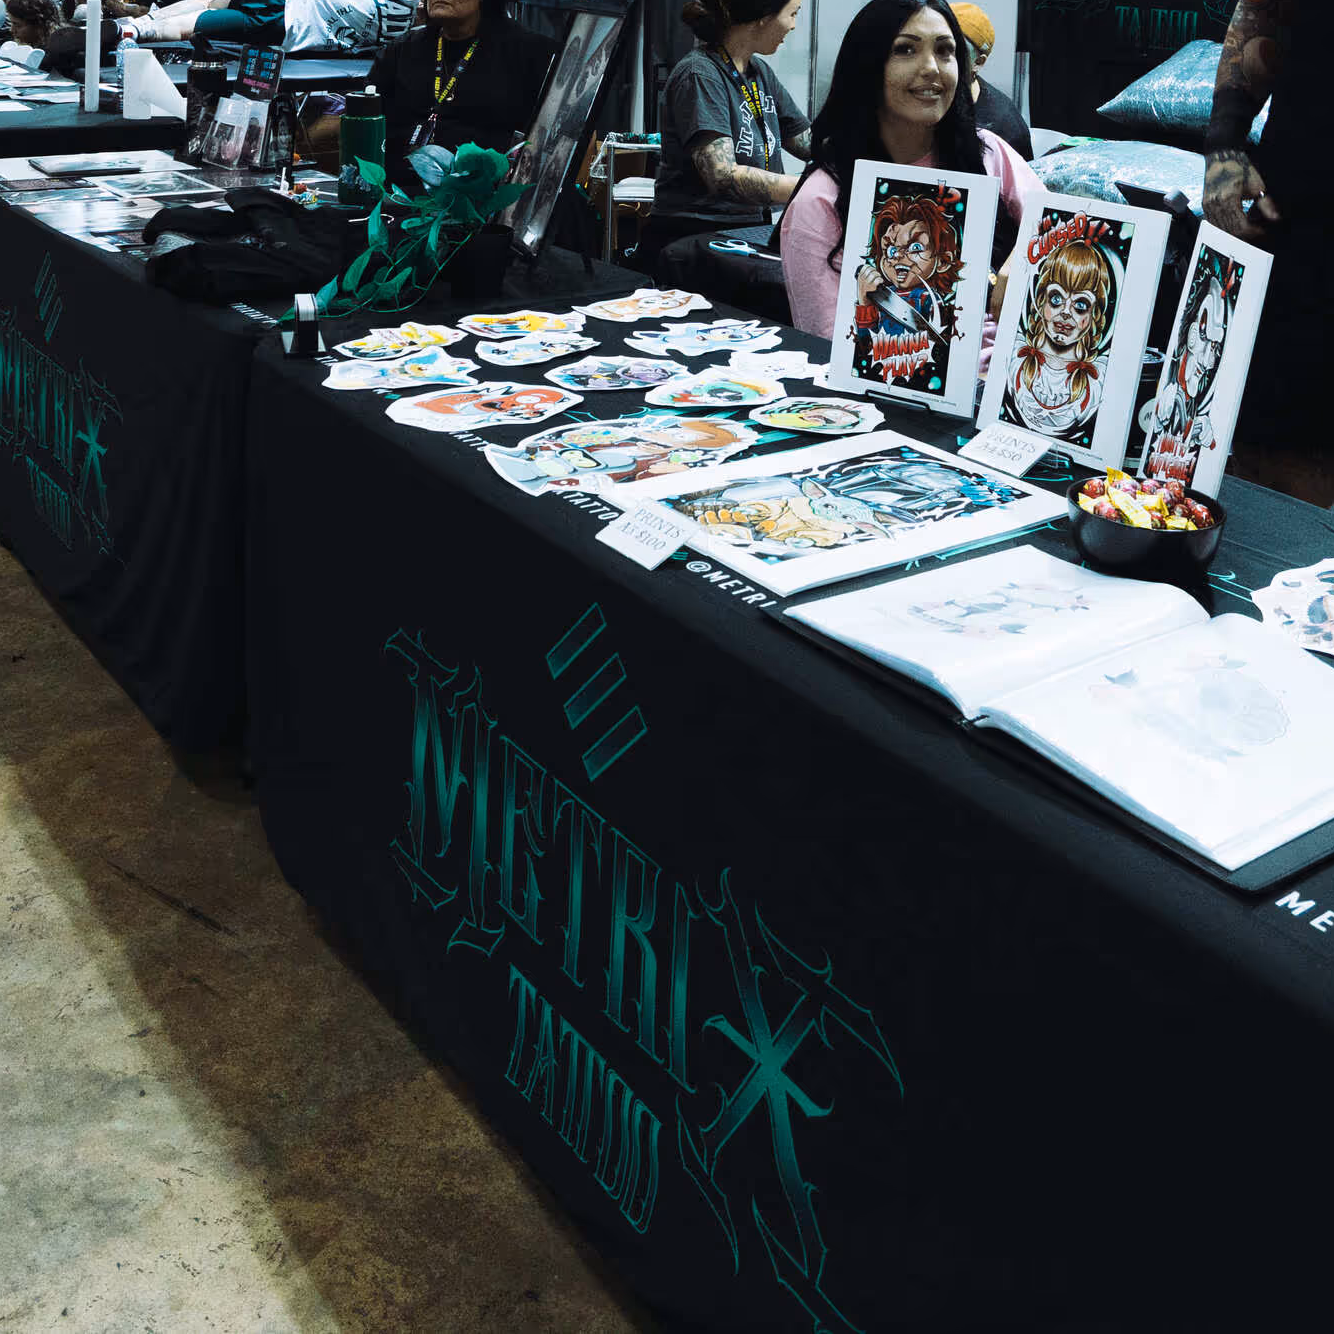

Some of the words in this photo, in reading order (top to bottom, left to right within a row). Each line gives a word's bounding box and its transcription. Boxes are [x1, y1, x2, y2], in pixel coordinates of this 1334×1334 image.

[872, 329, 930, 362] WANNA
[882, 352, 929, 383] PLAY?
[634, 527, 668, 552] $100
[635, 507, 685, 540] PRINTS
[685, 560, 778, 610] @METRI
[384, 626, 904, 1334] METRIX
[504, 962, 663, 1234] TATTOO
